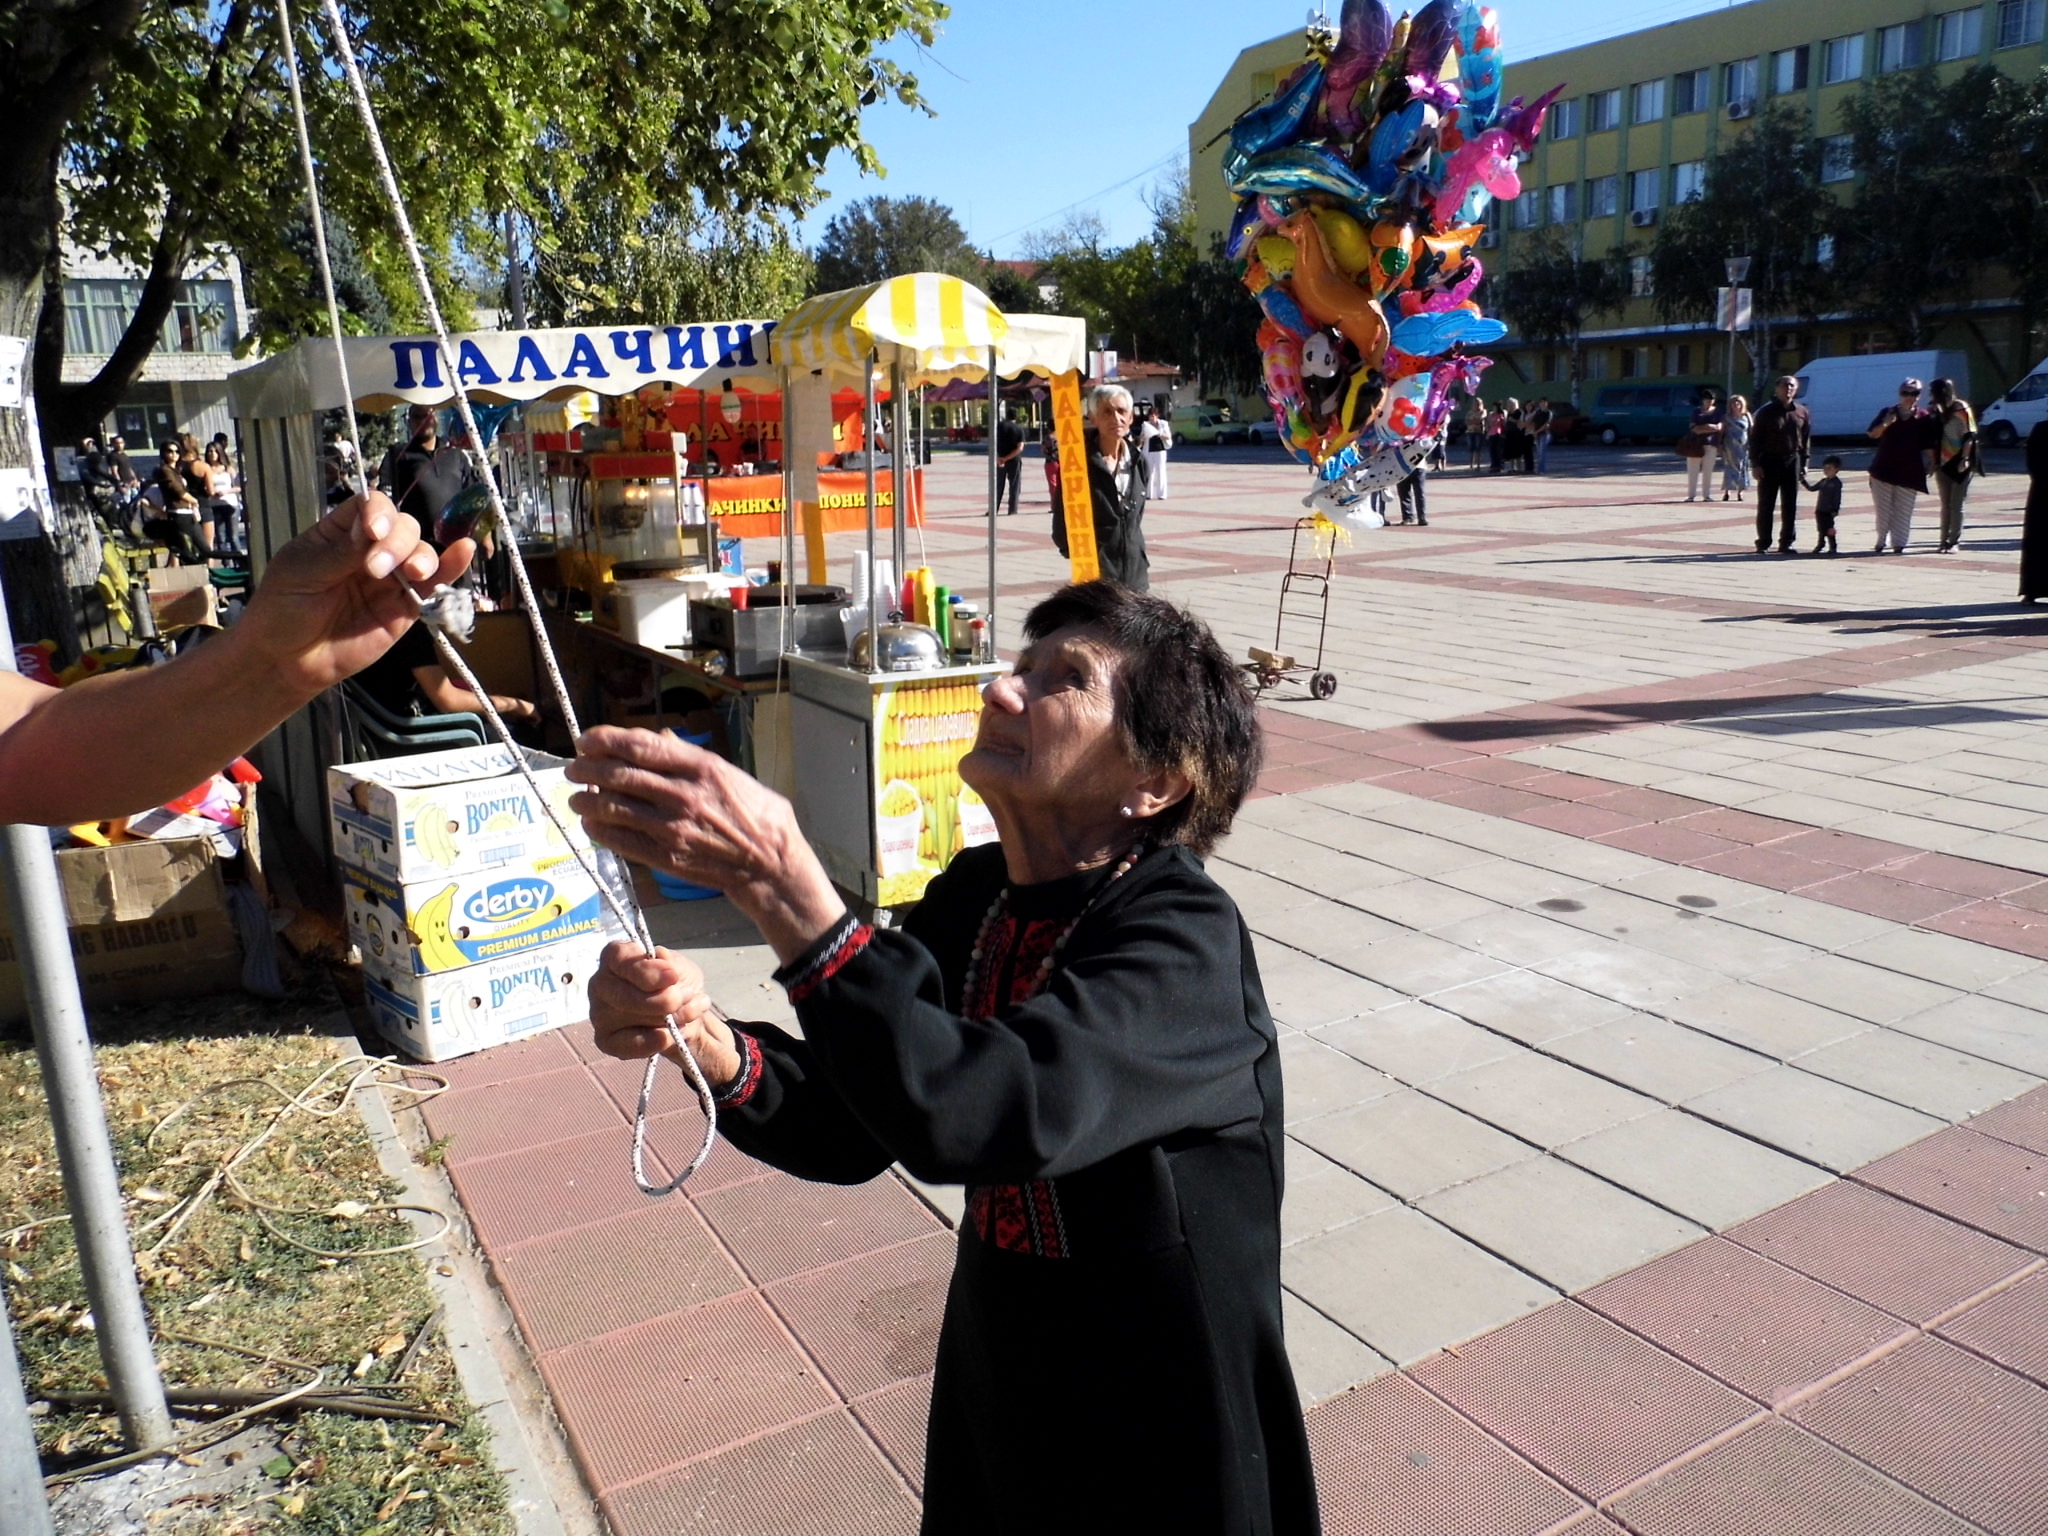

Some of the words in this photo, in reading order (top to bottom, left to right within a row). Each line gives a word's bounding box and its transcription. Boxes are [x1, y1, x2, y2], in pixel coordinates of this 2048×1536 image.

[709, 497, 787, 517] АЧИНКИ
[819, 491, 894, 509] ПОНИК
[368, 752, 515, 782] BANANA
[465, 795, 535, 835] BONITA
[470, 884, 549, 919] derby
[478, 932, 539, 956] PREMIUM
[542, 917, 599, 940] BANANAS
[494, 919, 530, 932] QUALITY
[489, 959, 531, 975] PREMIUM
[532, 954, 555, 964] PACK
[488, 965, 557, 1009] BONITA
